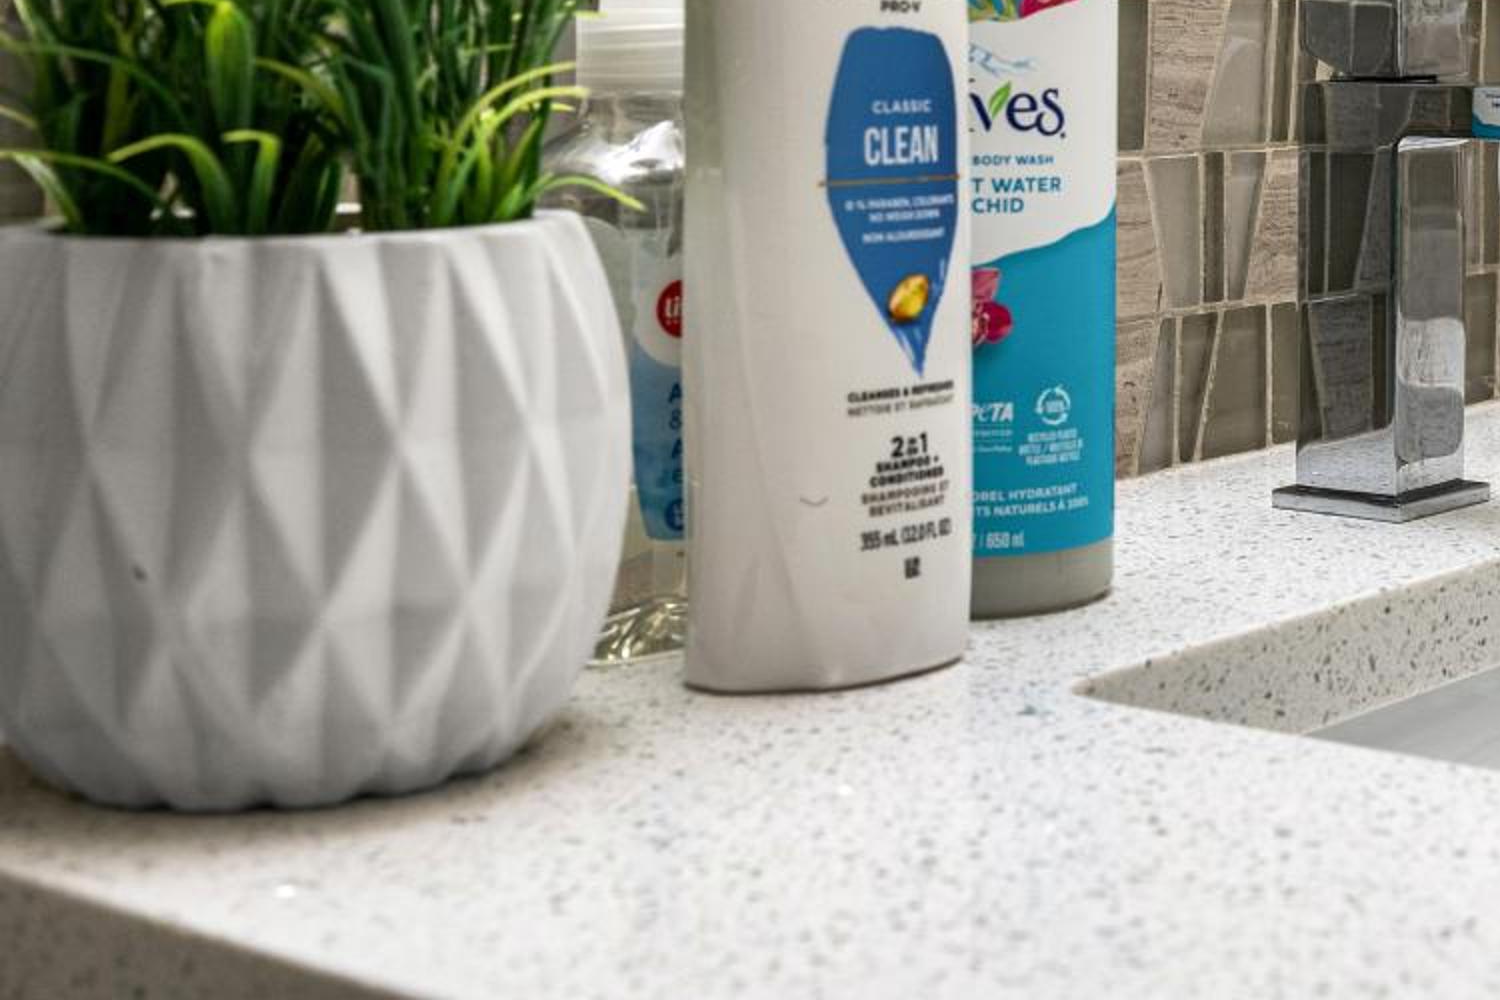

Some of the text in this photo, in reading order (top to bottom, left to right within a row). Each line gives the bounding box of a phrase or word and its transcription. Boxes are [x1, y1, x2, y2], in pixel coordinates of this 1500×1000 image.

[872, 99, 932, 115] CLASSIC
[863, 125, 939, 166] CLEAN
[971, 154, 1054, 166] BODY WASH
[991, 176, 1062, 193] WATER
[971, 197, 1025, 214] CHID
[876, 456, 930, 473] SHAMPOO
[869, 465, 944, 488] CONDITIONER
[861, 483, 937, 505] SHAMPOOING
[1008, 482, 1078, 500] HYDRATANT
[868, 494, 944, 517] REVITALISANT
[993, 501, 1056, 516] NATURELS
